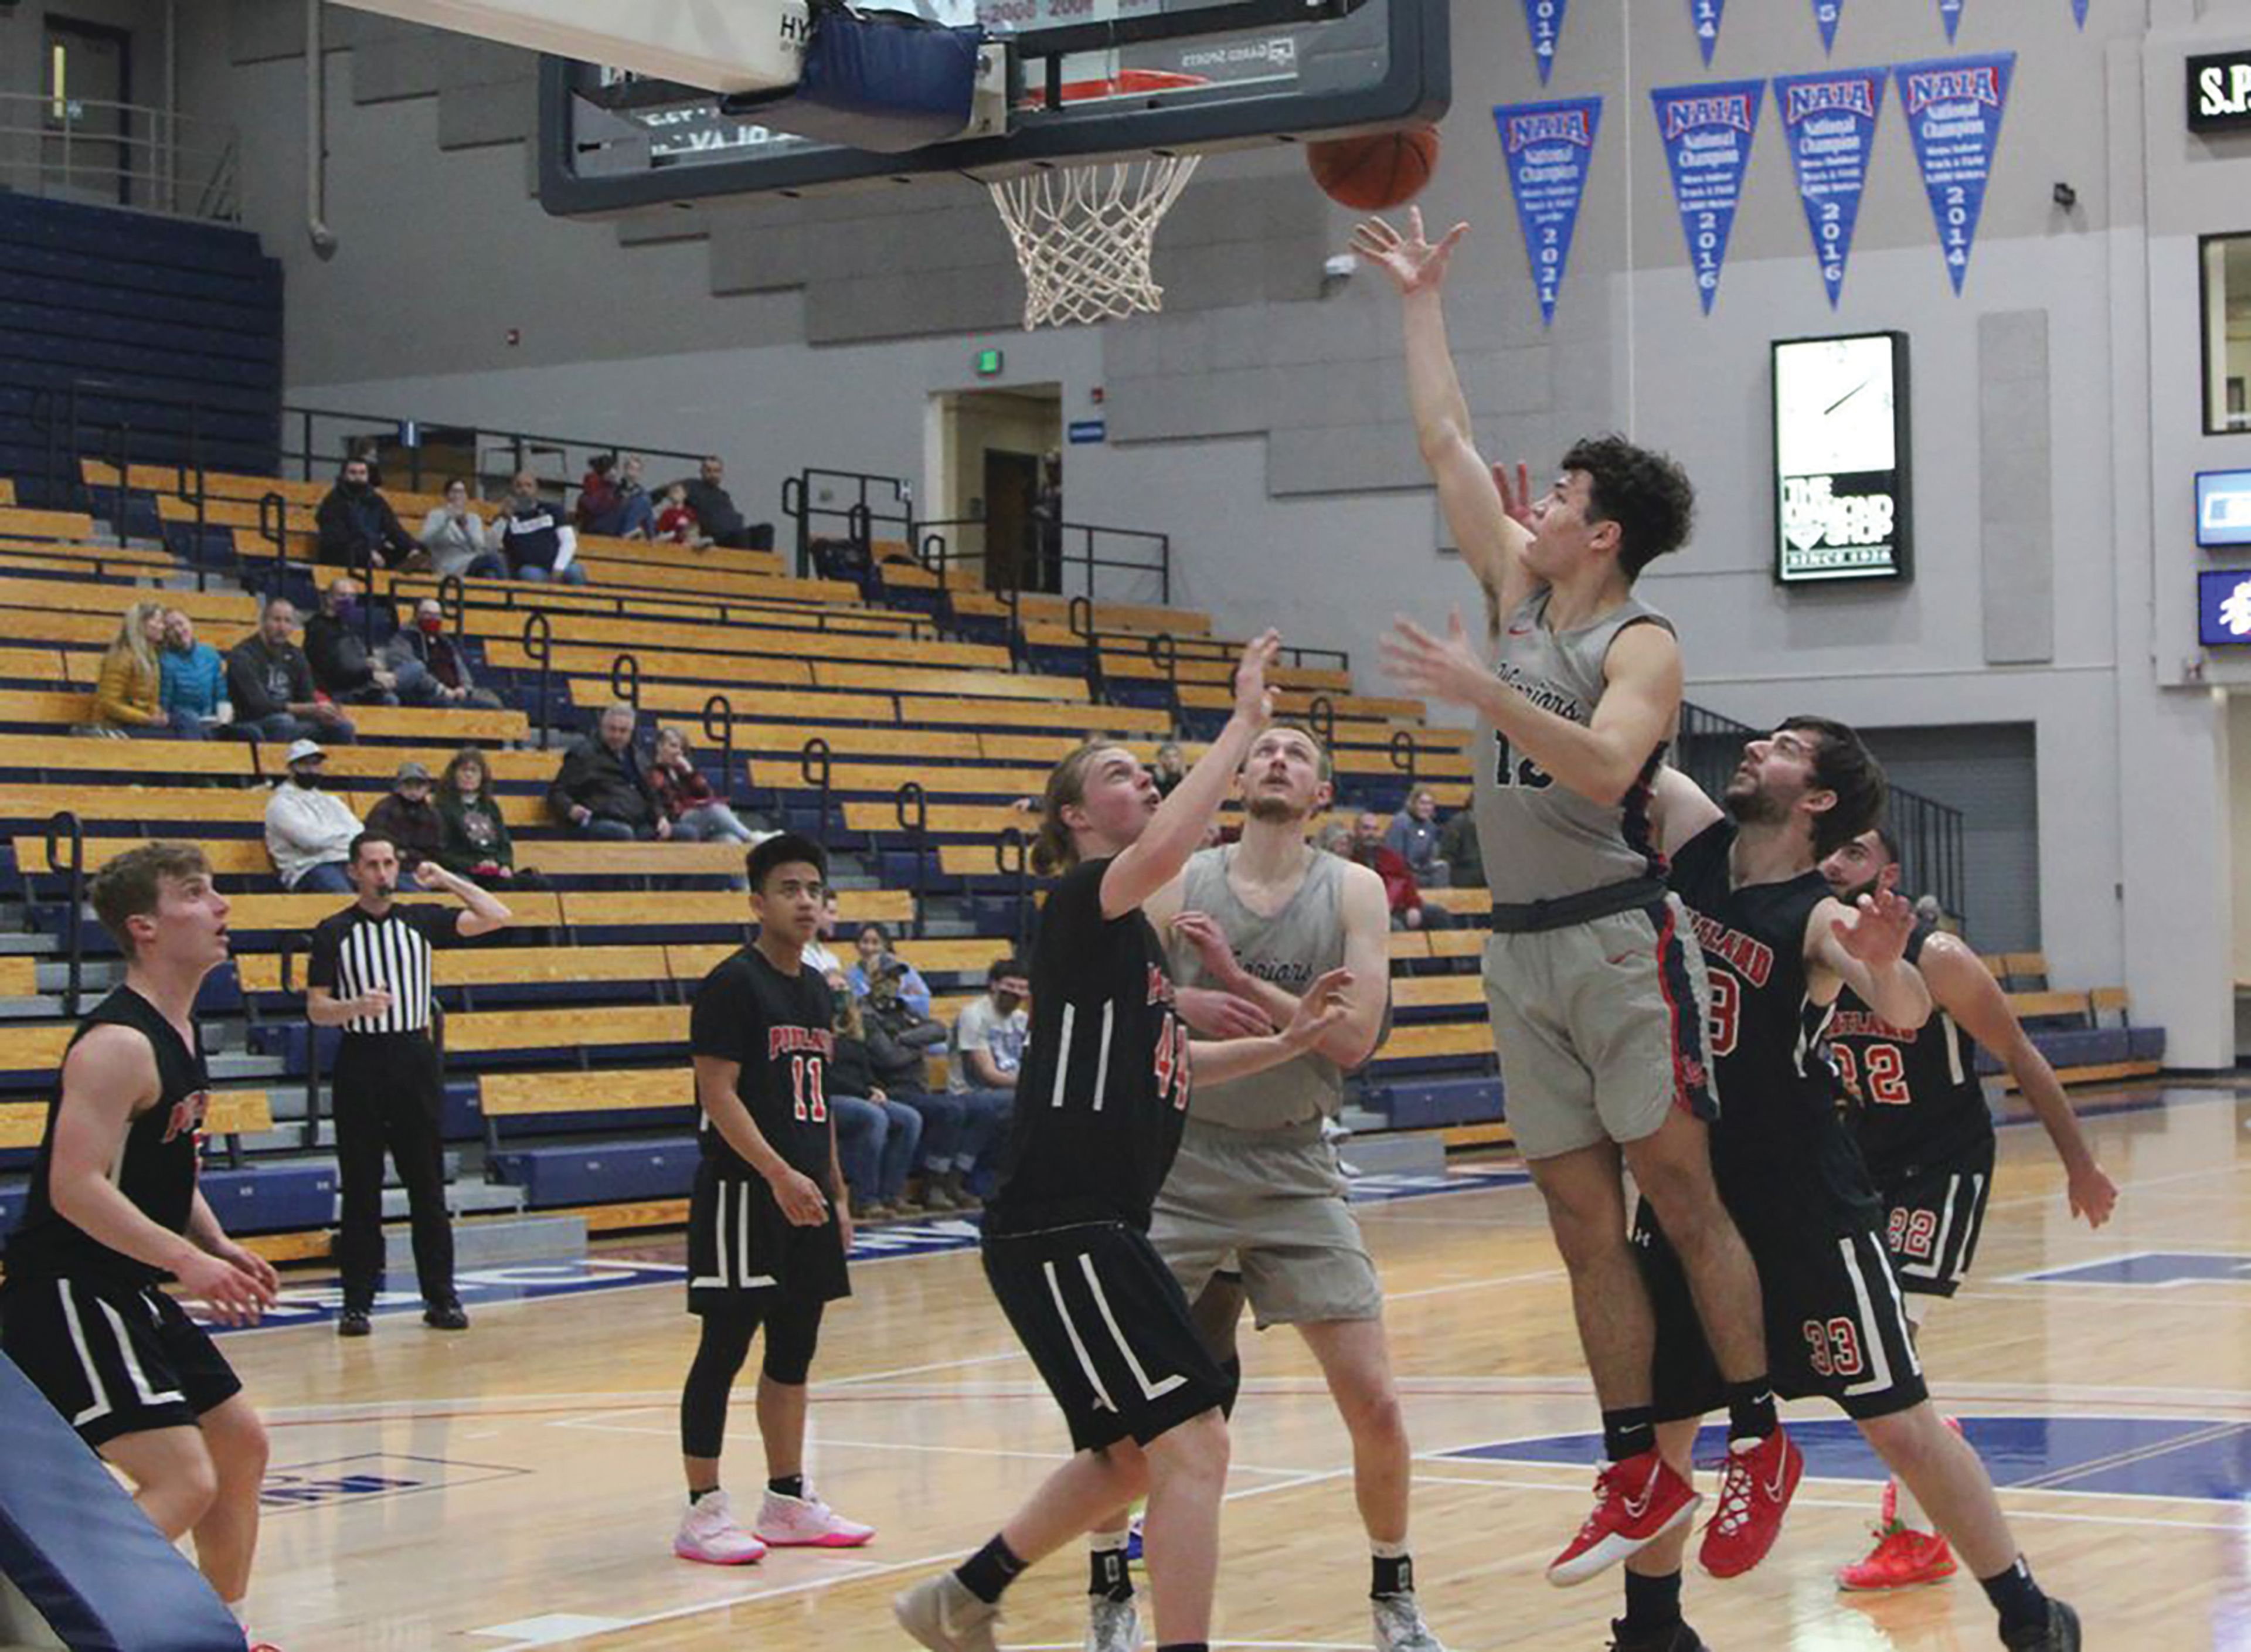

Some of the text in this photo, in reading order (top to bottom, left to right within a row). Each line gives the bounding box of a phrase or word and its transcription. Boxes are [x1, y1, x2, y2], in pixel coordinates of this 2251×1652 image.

[1667, 95, 1751, 139] NAIA
[1787, 80, 1874, 125] NAIA
[1907, 66, 1999, 114] NAIA
[1926, 99, 1980, 120] National
[1683, 128, 1736, 149] National
[1803, 115, 1856, 135] National
[1698, 212, 1716, 288] 2016
[1822, 202, 1842, 281] 2016
[1946, 186, 1967, 266] 2014
[1541, 227, 1559, 302] 2021
[792, 1055, 827, 1123] 11
[1803, 1316, 1864, 1376] 33
